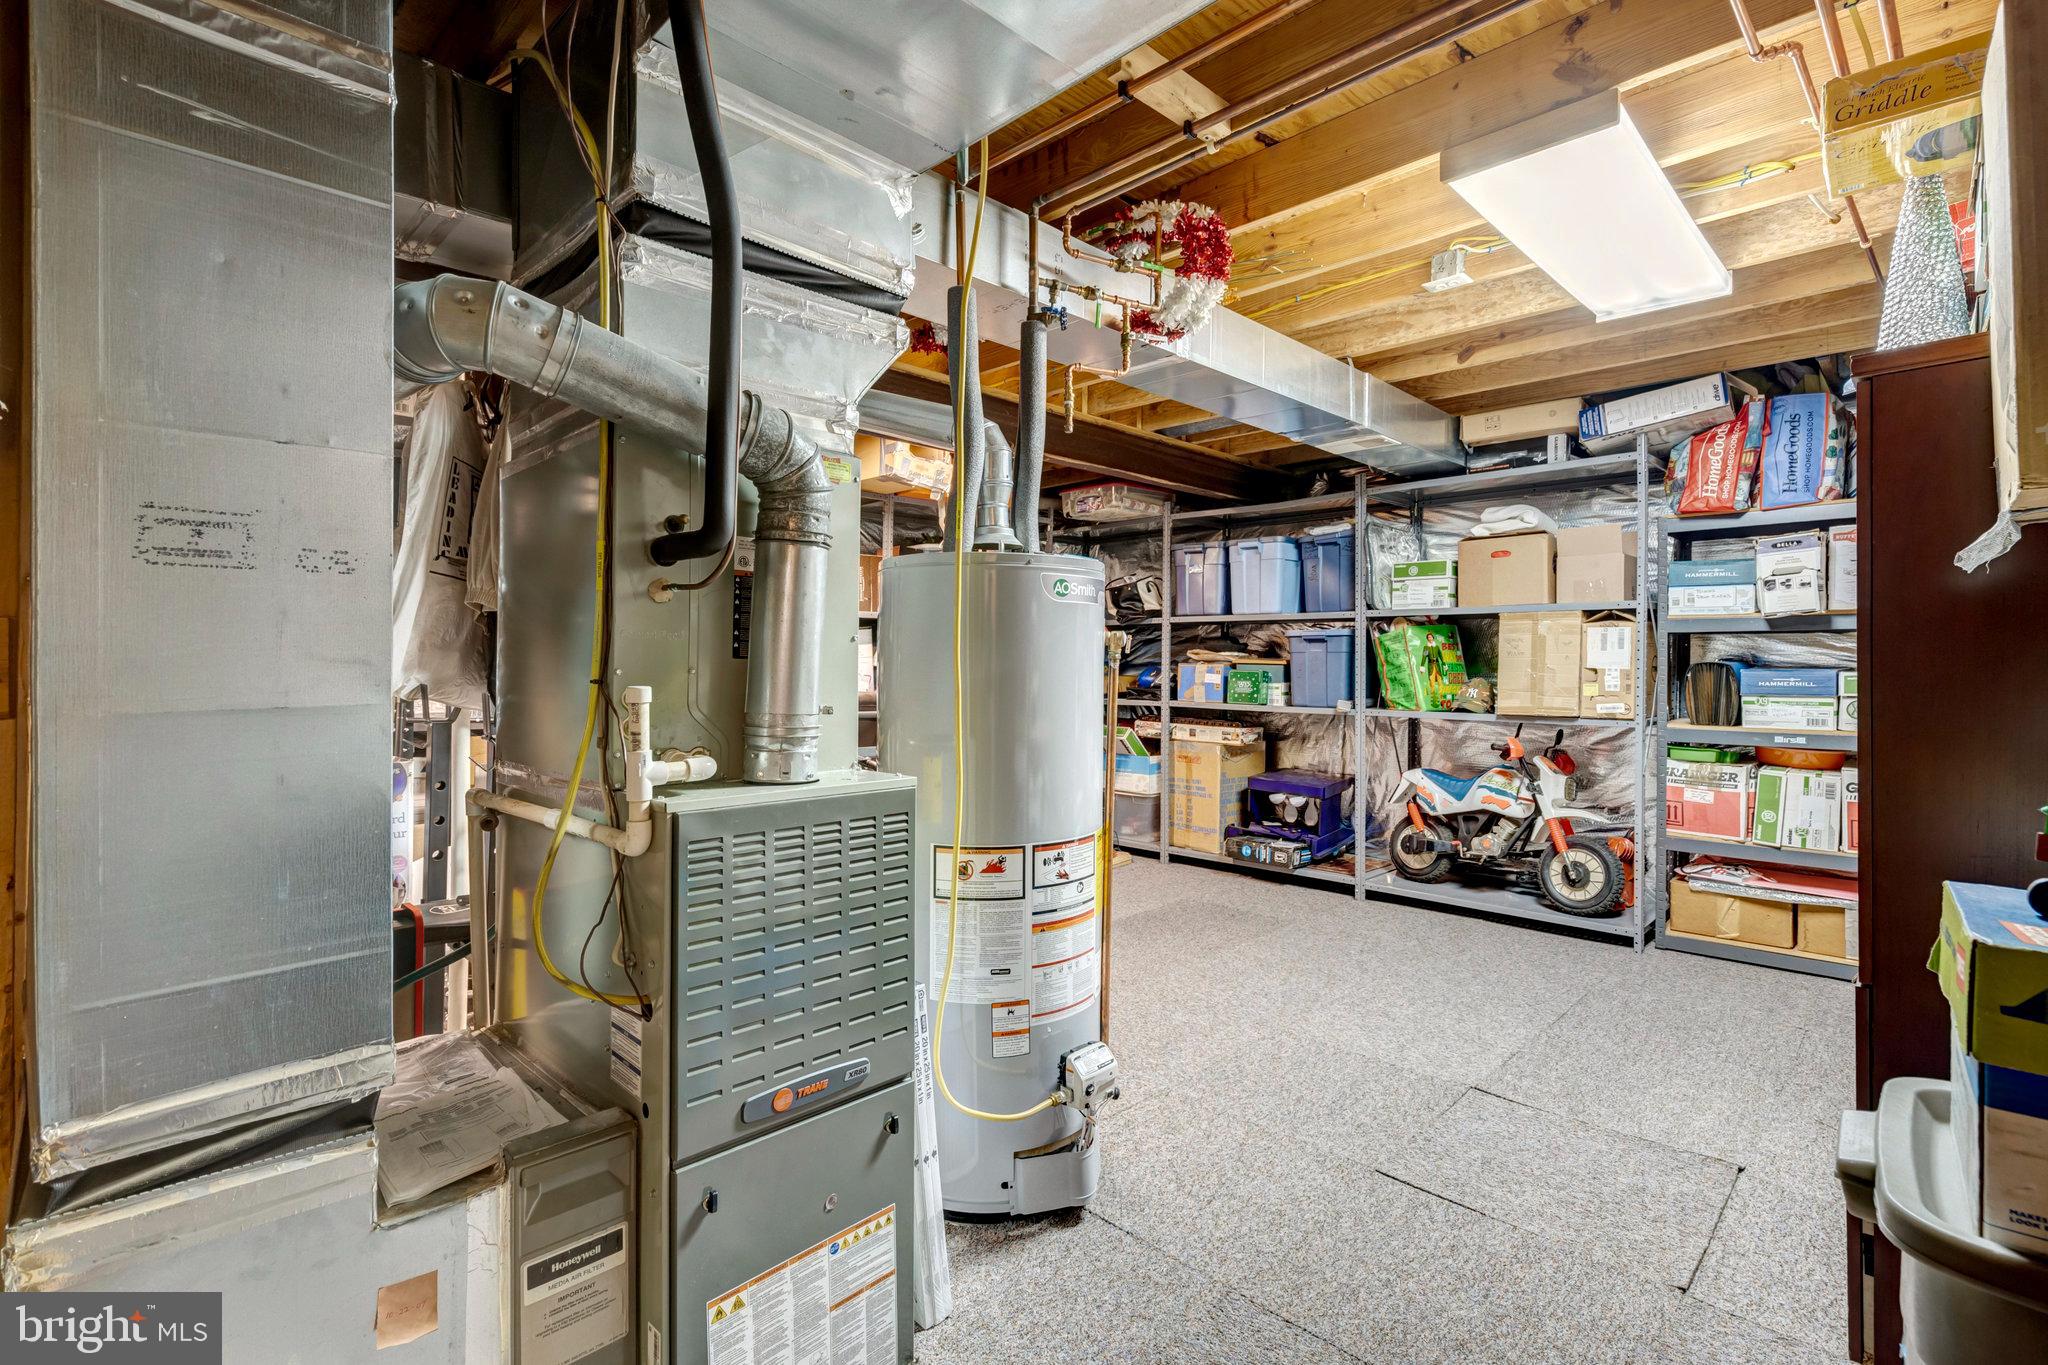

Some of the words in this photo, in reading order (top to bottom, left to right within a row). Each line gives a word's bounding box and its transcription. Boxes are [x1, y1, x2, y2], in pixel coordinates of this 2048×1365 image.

[1888, 73, 1926, 92] Electric
[1835, 83, 1932, 122] Griddle
[1712, 384, 1721, 402] drive
[1804, 411, 1815, 473] HOMEGOODS.COM
[1702, 422, 1731, 499] HomeGoods
[1782, 413, 1801, 494] HomeGoods
[1722, 480, 1730, 499] SHOP
[1666, 766, 1741, 783] RAGER.
[914, 1041, 920, 1052] 20
[922, 1036, 928, 1049] 20
[847, 1066, 868, 1079] XR80
[915, 1066, 922, 1078] 25
[923, 1062, 931, 1073] 25
[796, 1078, 829, 1100] TRANE
[551, 1244, 602, 1273] Honeywell
[547, 1278, 570, 1291] MEDIA
[570, 1272, 582, 1281] AIR
[582, 1262, 606, 1277] FILTER
[557, 1282, 597, 1303] IMPORTANT
